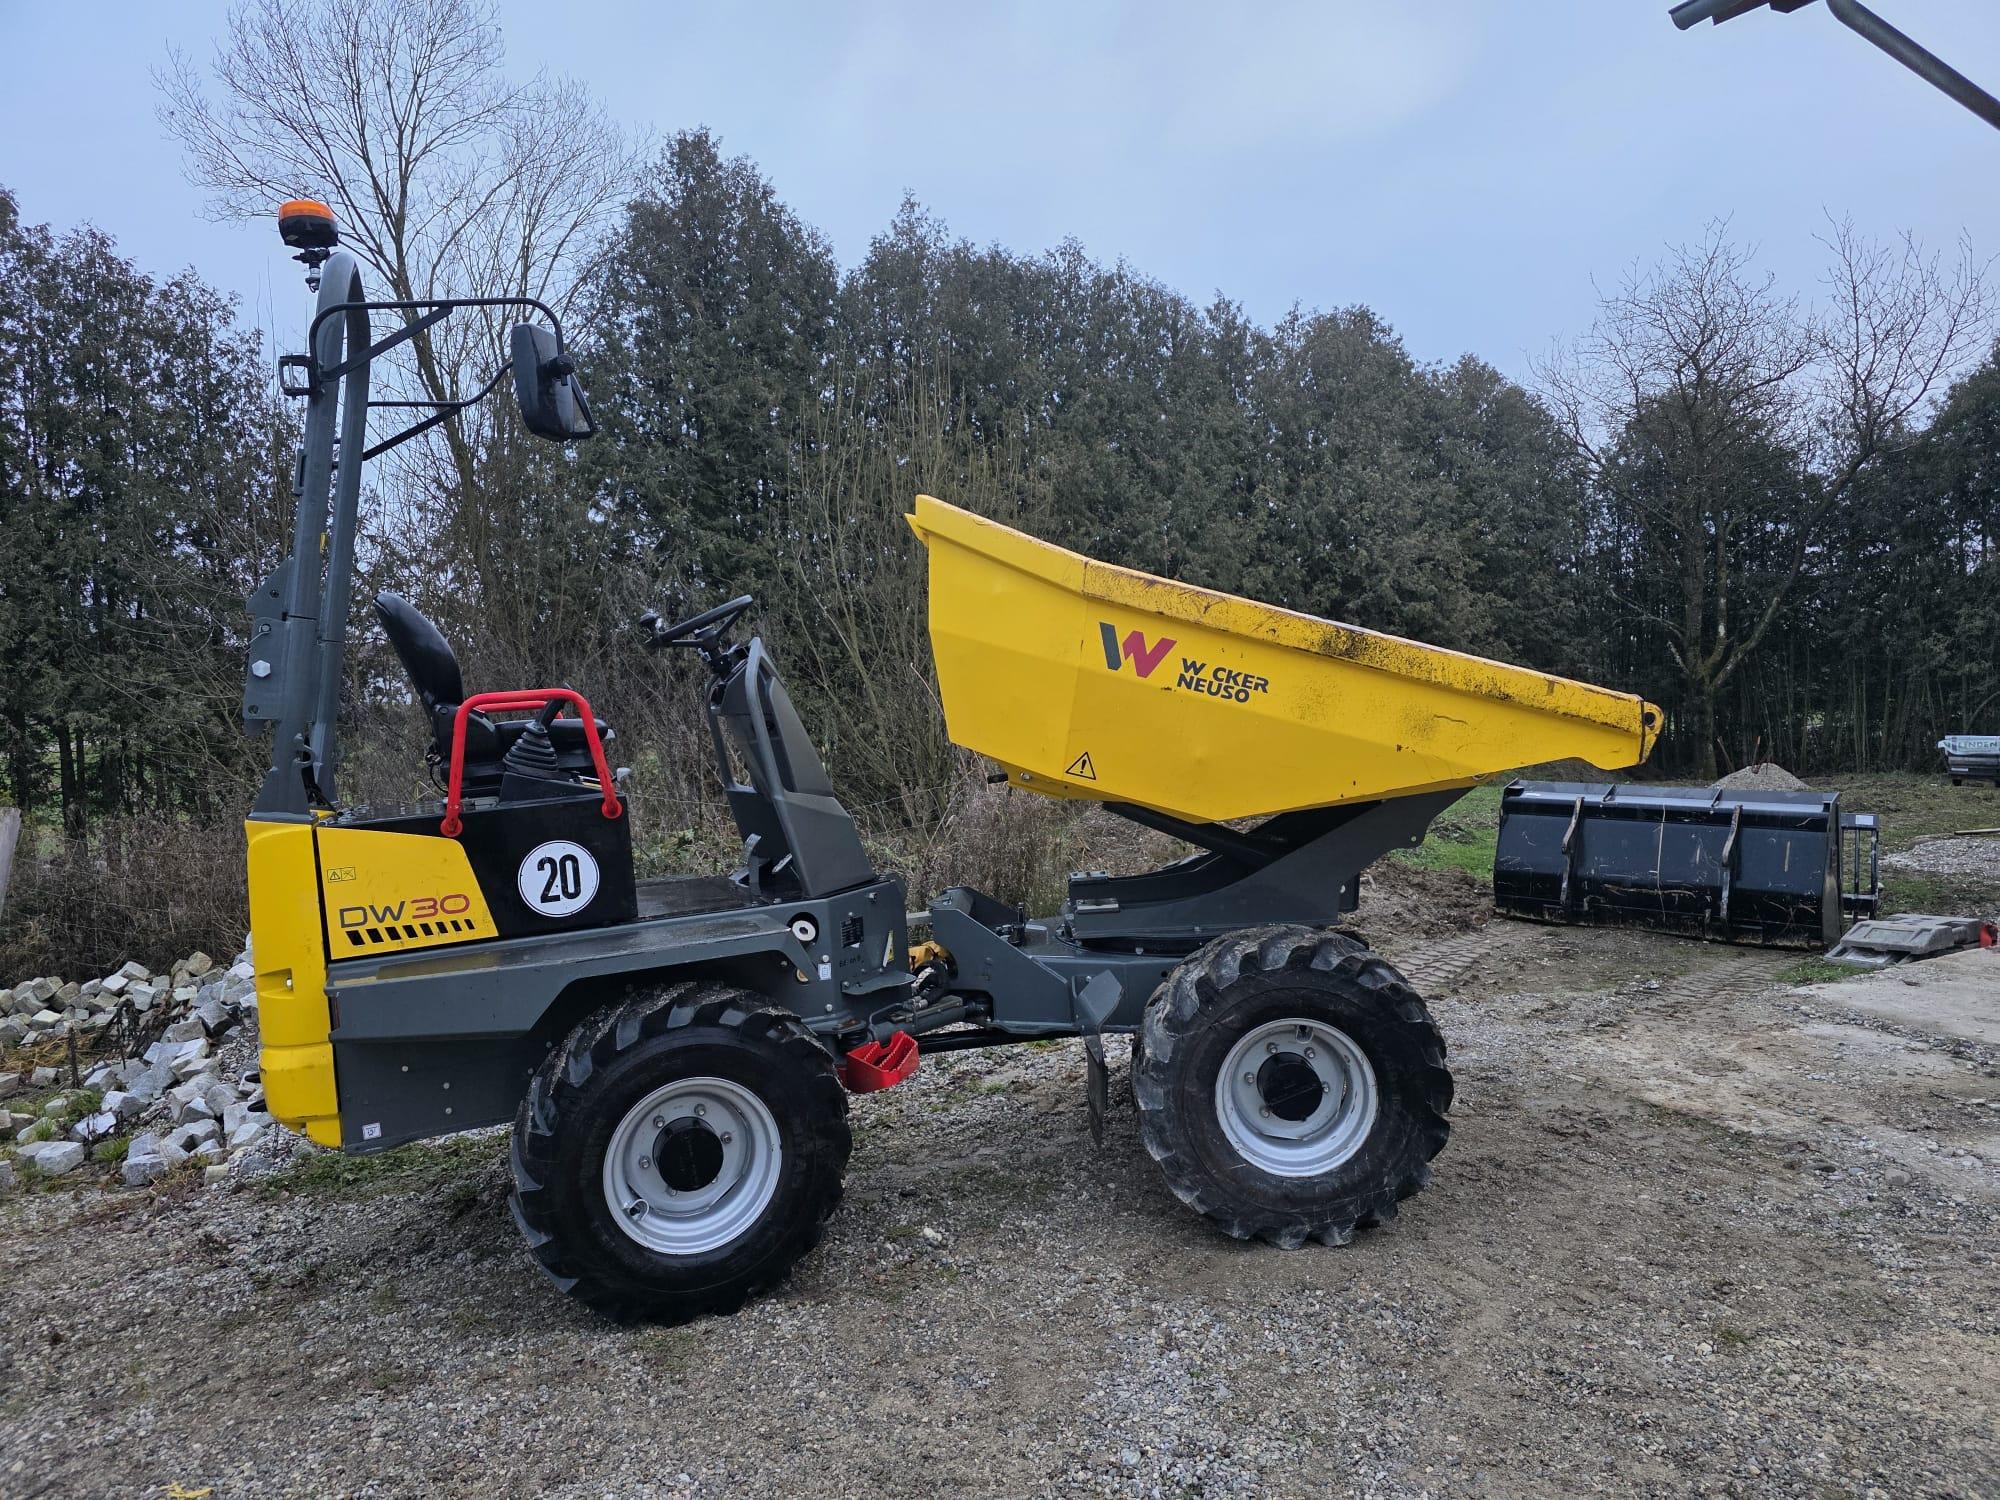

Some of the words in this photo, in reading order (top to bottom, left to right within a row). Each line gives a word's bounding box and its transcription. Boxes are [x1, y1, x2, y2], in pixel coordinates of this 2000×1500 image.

[1181, 657, 1269, 694] WCKER
[536, 853, 582, 904] 20
[339, 893, 471, 929] DW30
